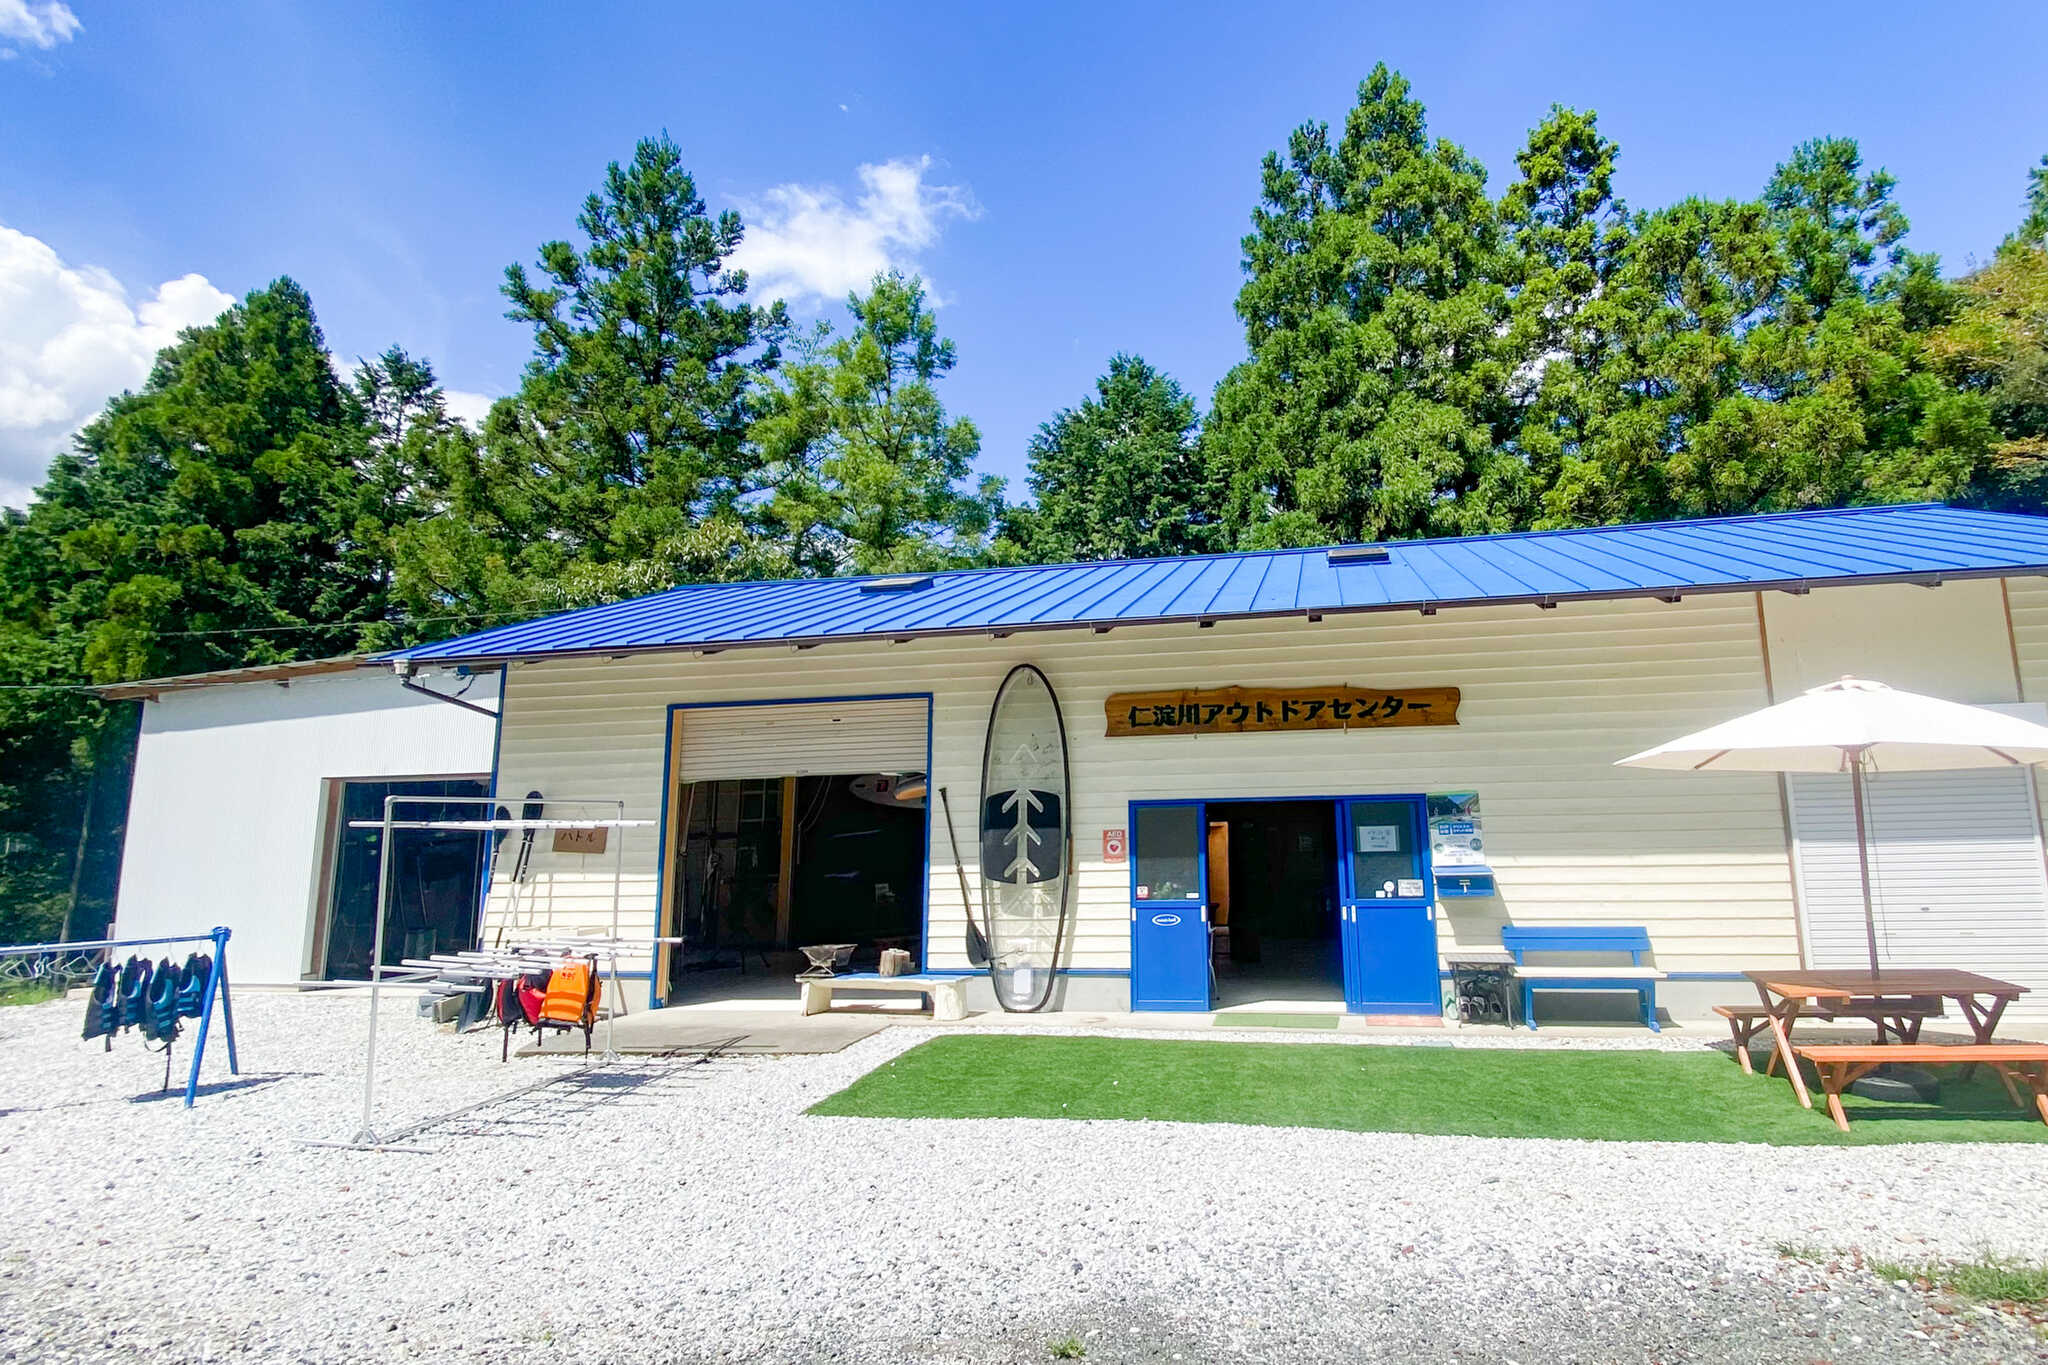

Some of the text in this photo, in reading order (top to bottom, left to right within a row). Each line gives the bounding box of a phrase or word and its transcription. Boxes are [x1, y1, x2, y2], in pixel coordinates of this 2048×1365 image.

[1128, 696, 1432, 728] 仁淀川アウトドアセンター
